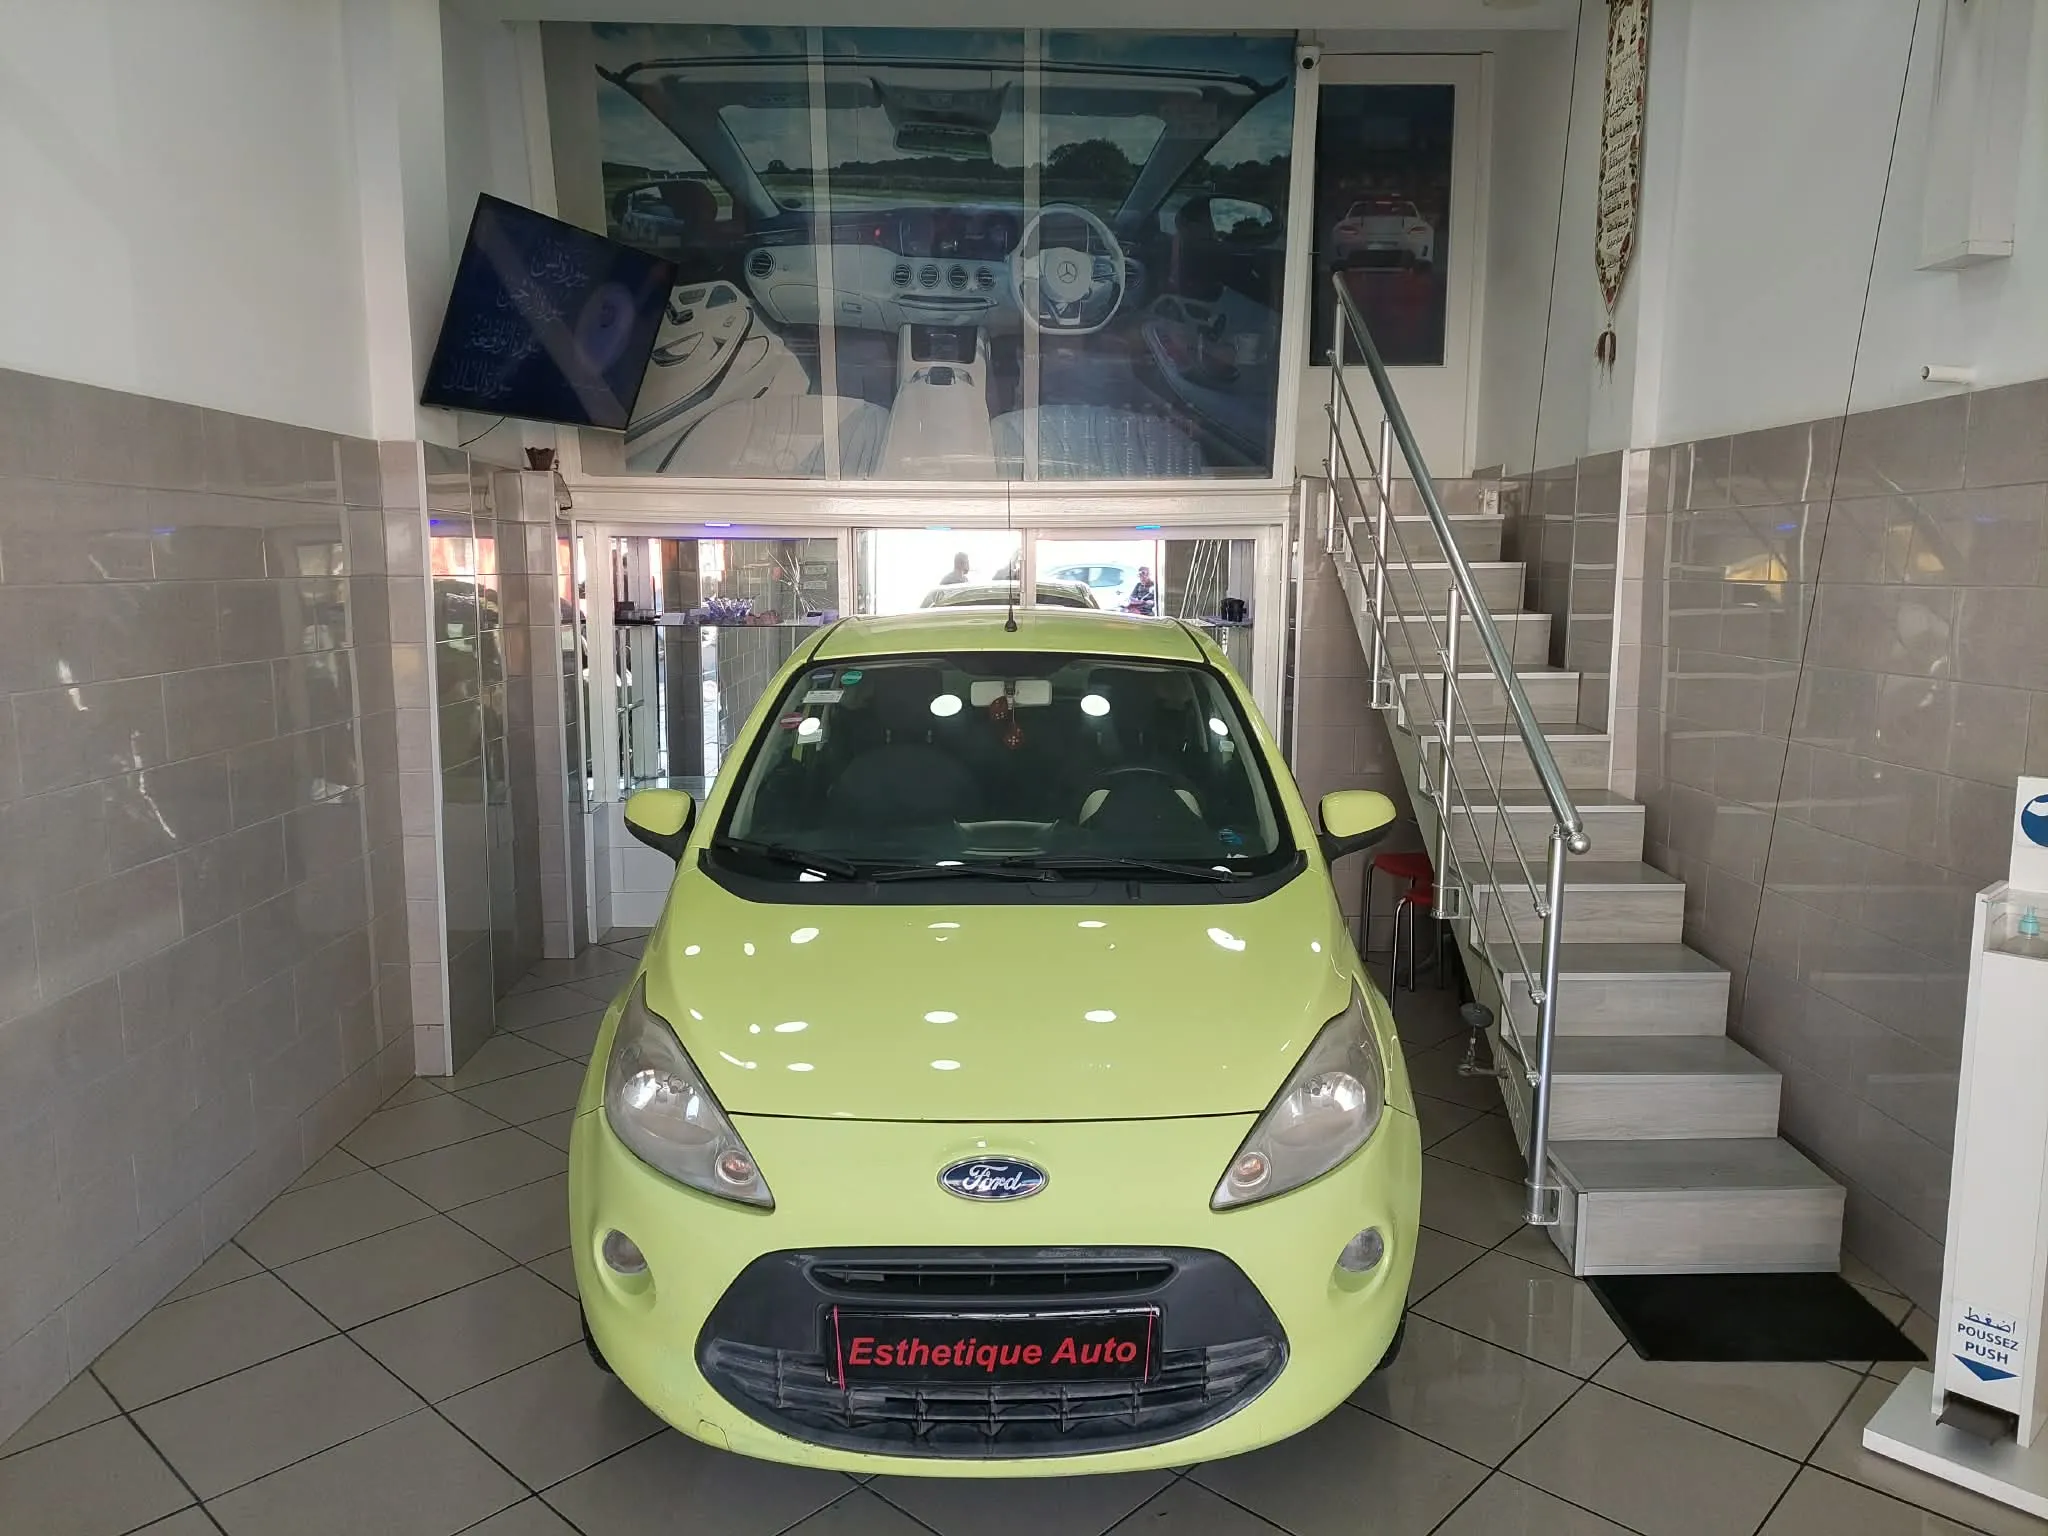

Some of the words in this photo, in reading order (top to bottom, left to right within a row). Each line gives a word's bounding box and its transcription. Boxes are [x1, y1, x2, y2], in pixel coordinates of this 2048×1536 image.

[962, 1164, 1024, 1192] Ford
[1964, 1306, 2016, 1334] اضغط
[1957, 1322, 2020, 1352] POUSSEZ
[848, 1337, 1042, 1373] Esthetique
[1052, 1336, 1138, 1365] Auto
[1965, 1341, 2009, 1365] PUSH
